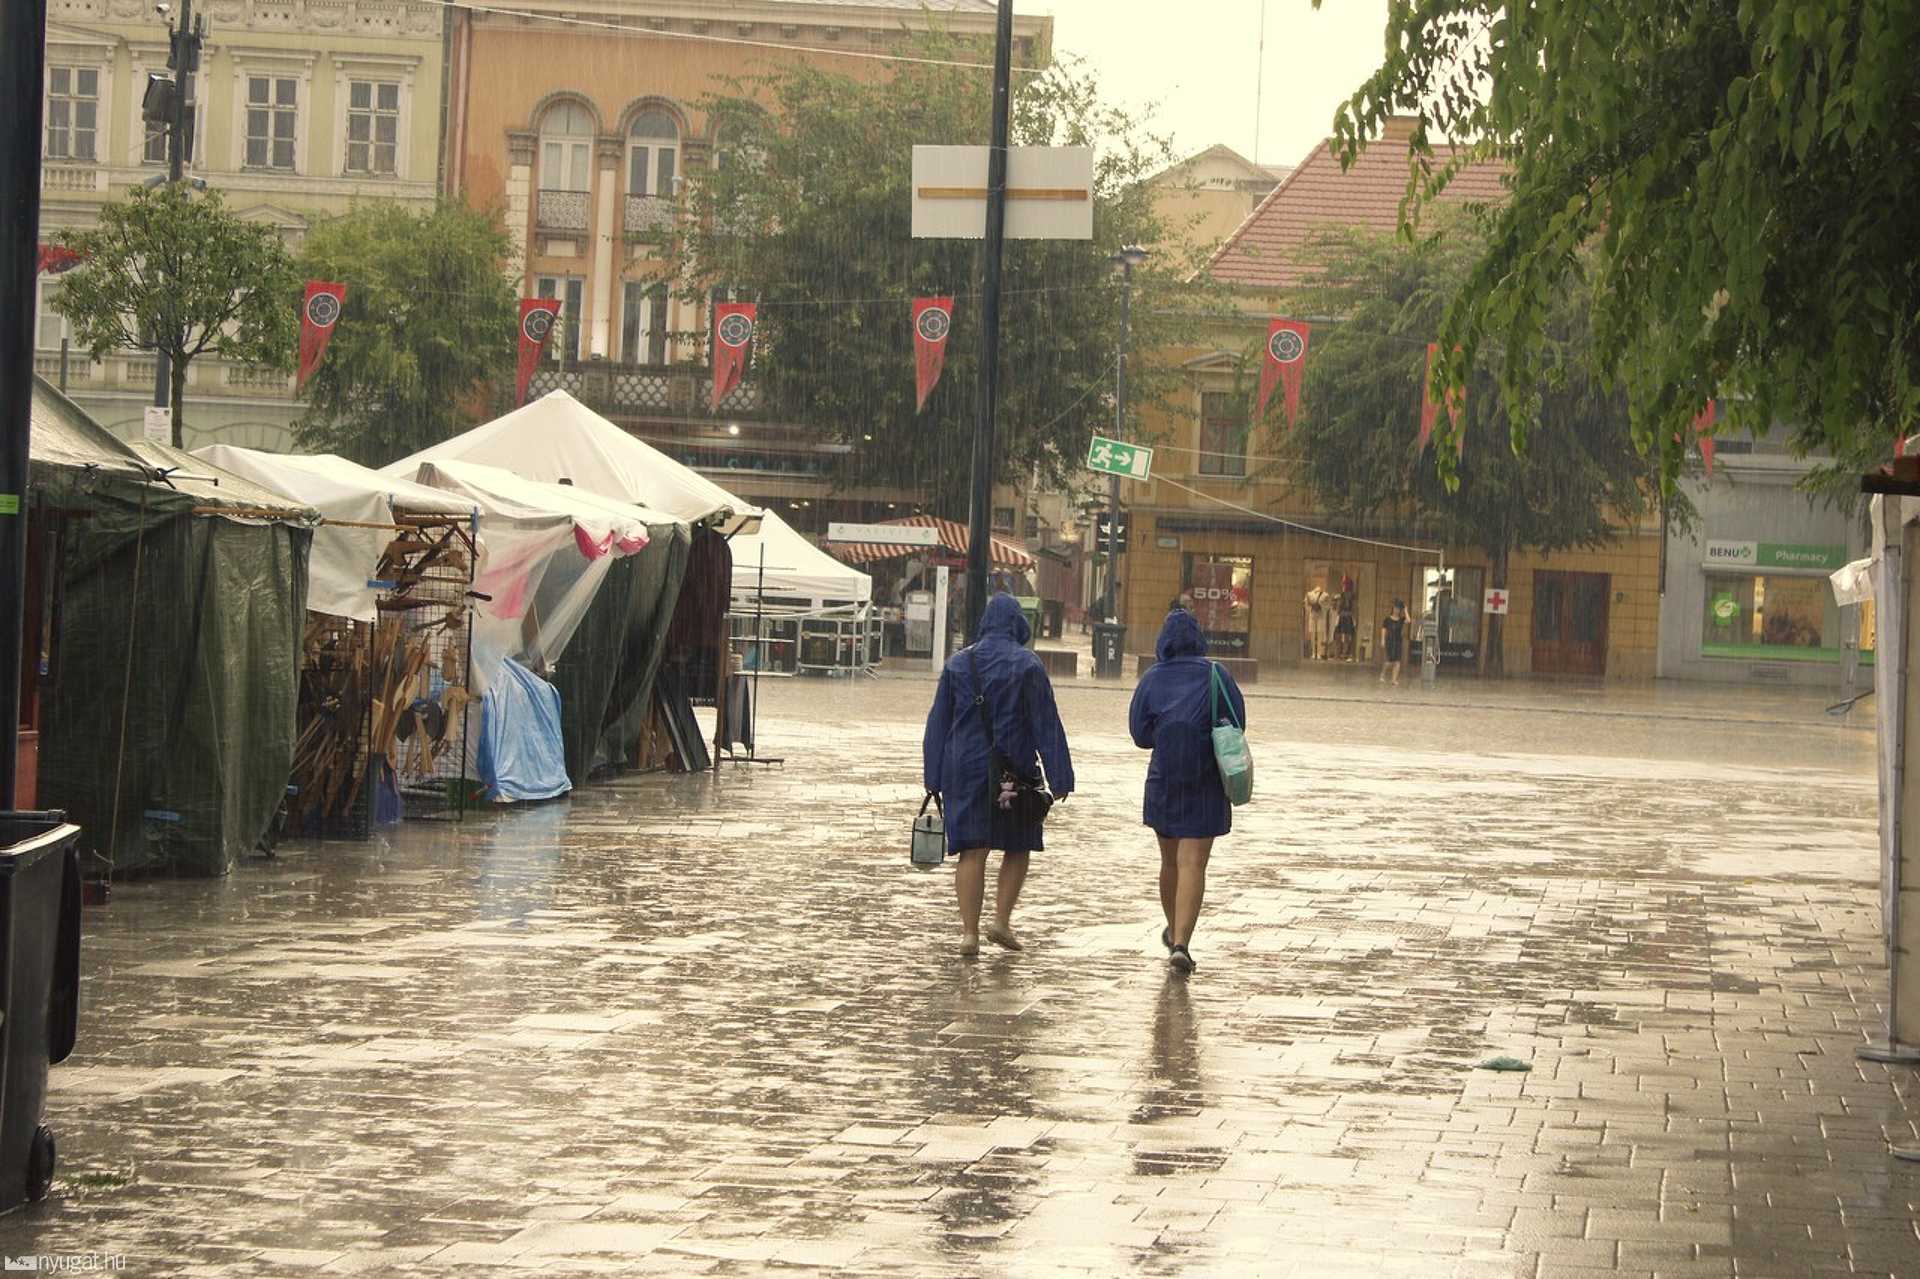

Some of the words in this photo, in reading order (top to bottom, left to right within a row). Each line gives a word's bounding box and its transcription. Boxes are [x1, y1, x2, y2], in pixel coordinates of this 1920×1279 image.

[1709, 546, 1740, 558] BENU
[1775, 549, 1829, 564] Pharmacy
[1193, 586, 1237, 601] 50%
